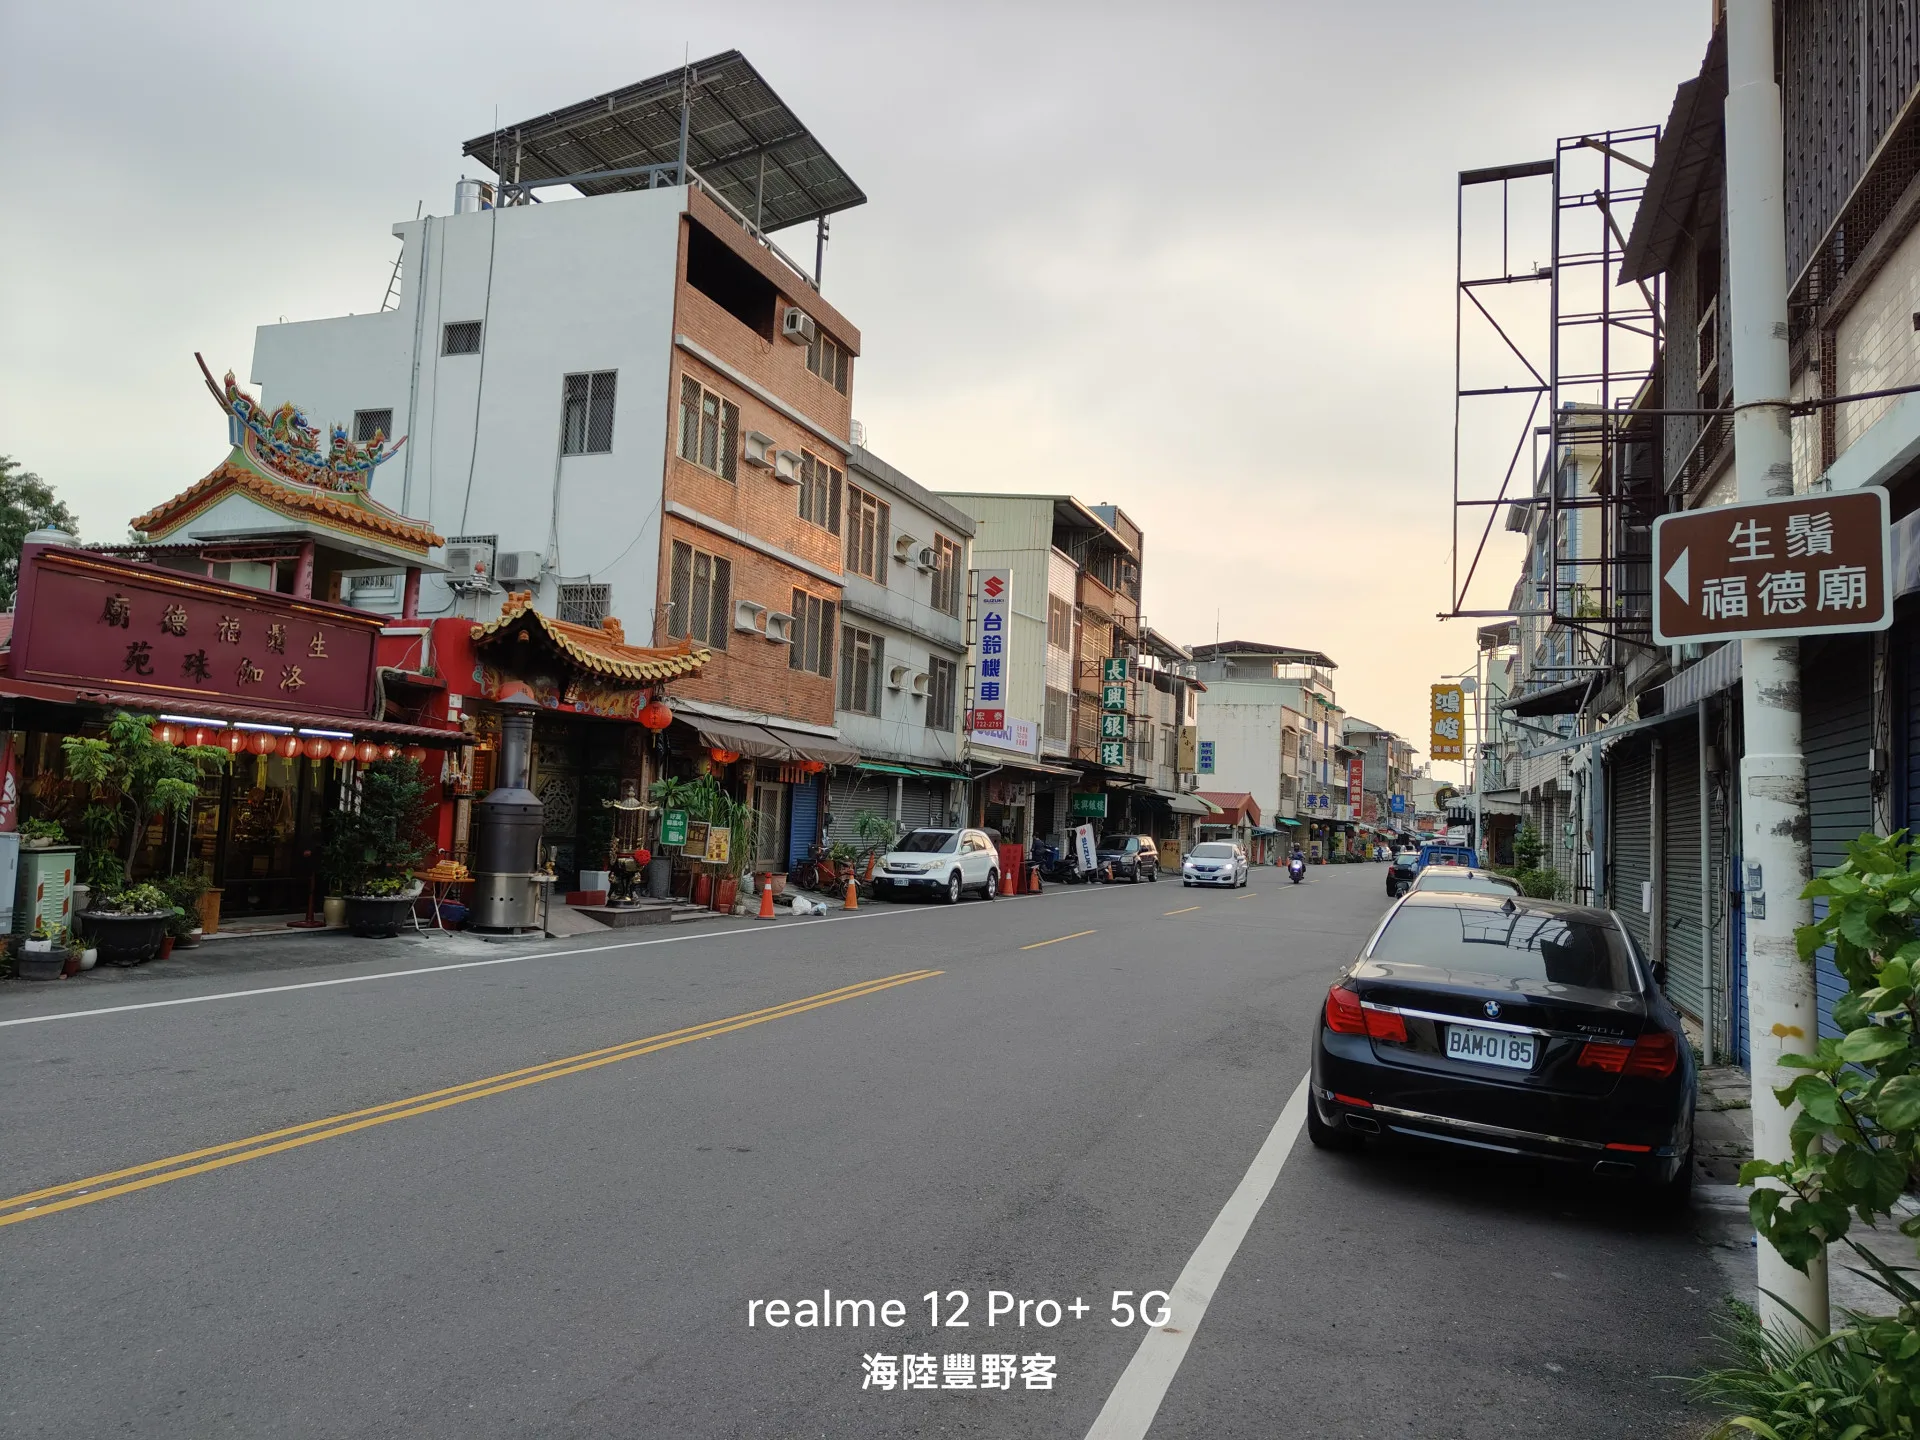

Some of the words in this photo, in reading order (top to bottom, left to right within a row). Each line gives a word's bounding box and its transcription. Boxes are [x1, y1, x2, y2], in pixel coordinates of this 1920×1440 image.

[1728, 511, 1834, 563] 生鬚
[1702, 565, 1867, 620] 福德廟
[981, 612, 1002, 701] 台鈴機車
[1103, 659, 1124, 765] 長興銀樓
[1073, 799, 1105, 812] 長興銀樓
[1307, 794, 1329, 808] 素食
[1081, 837, 1092, 869] SUZUKI
